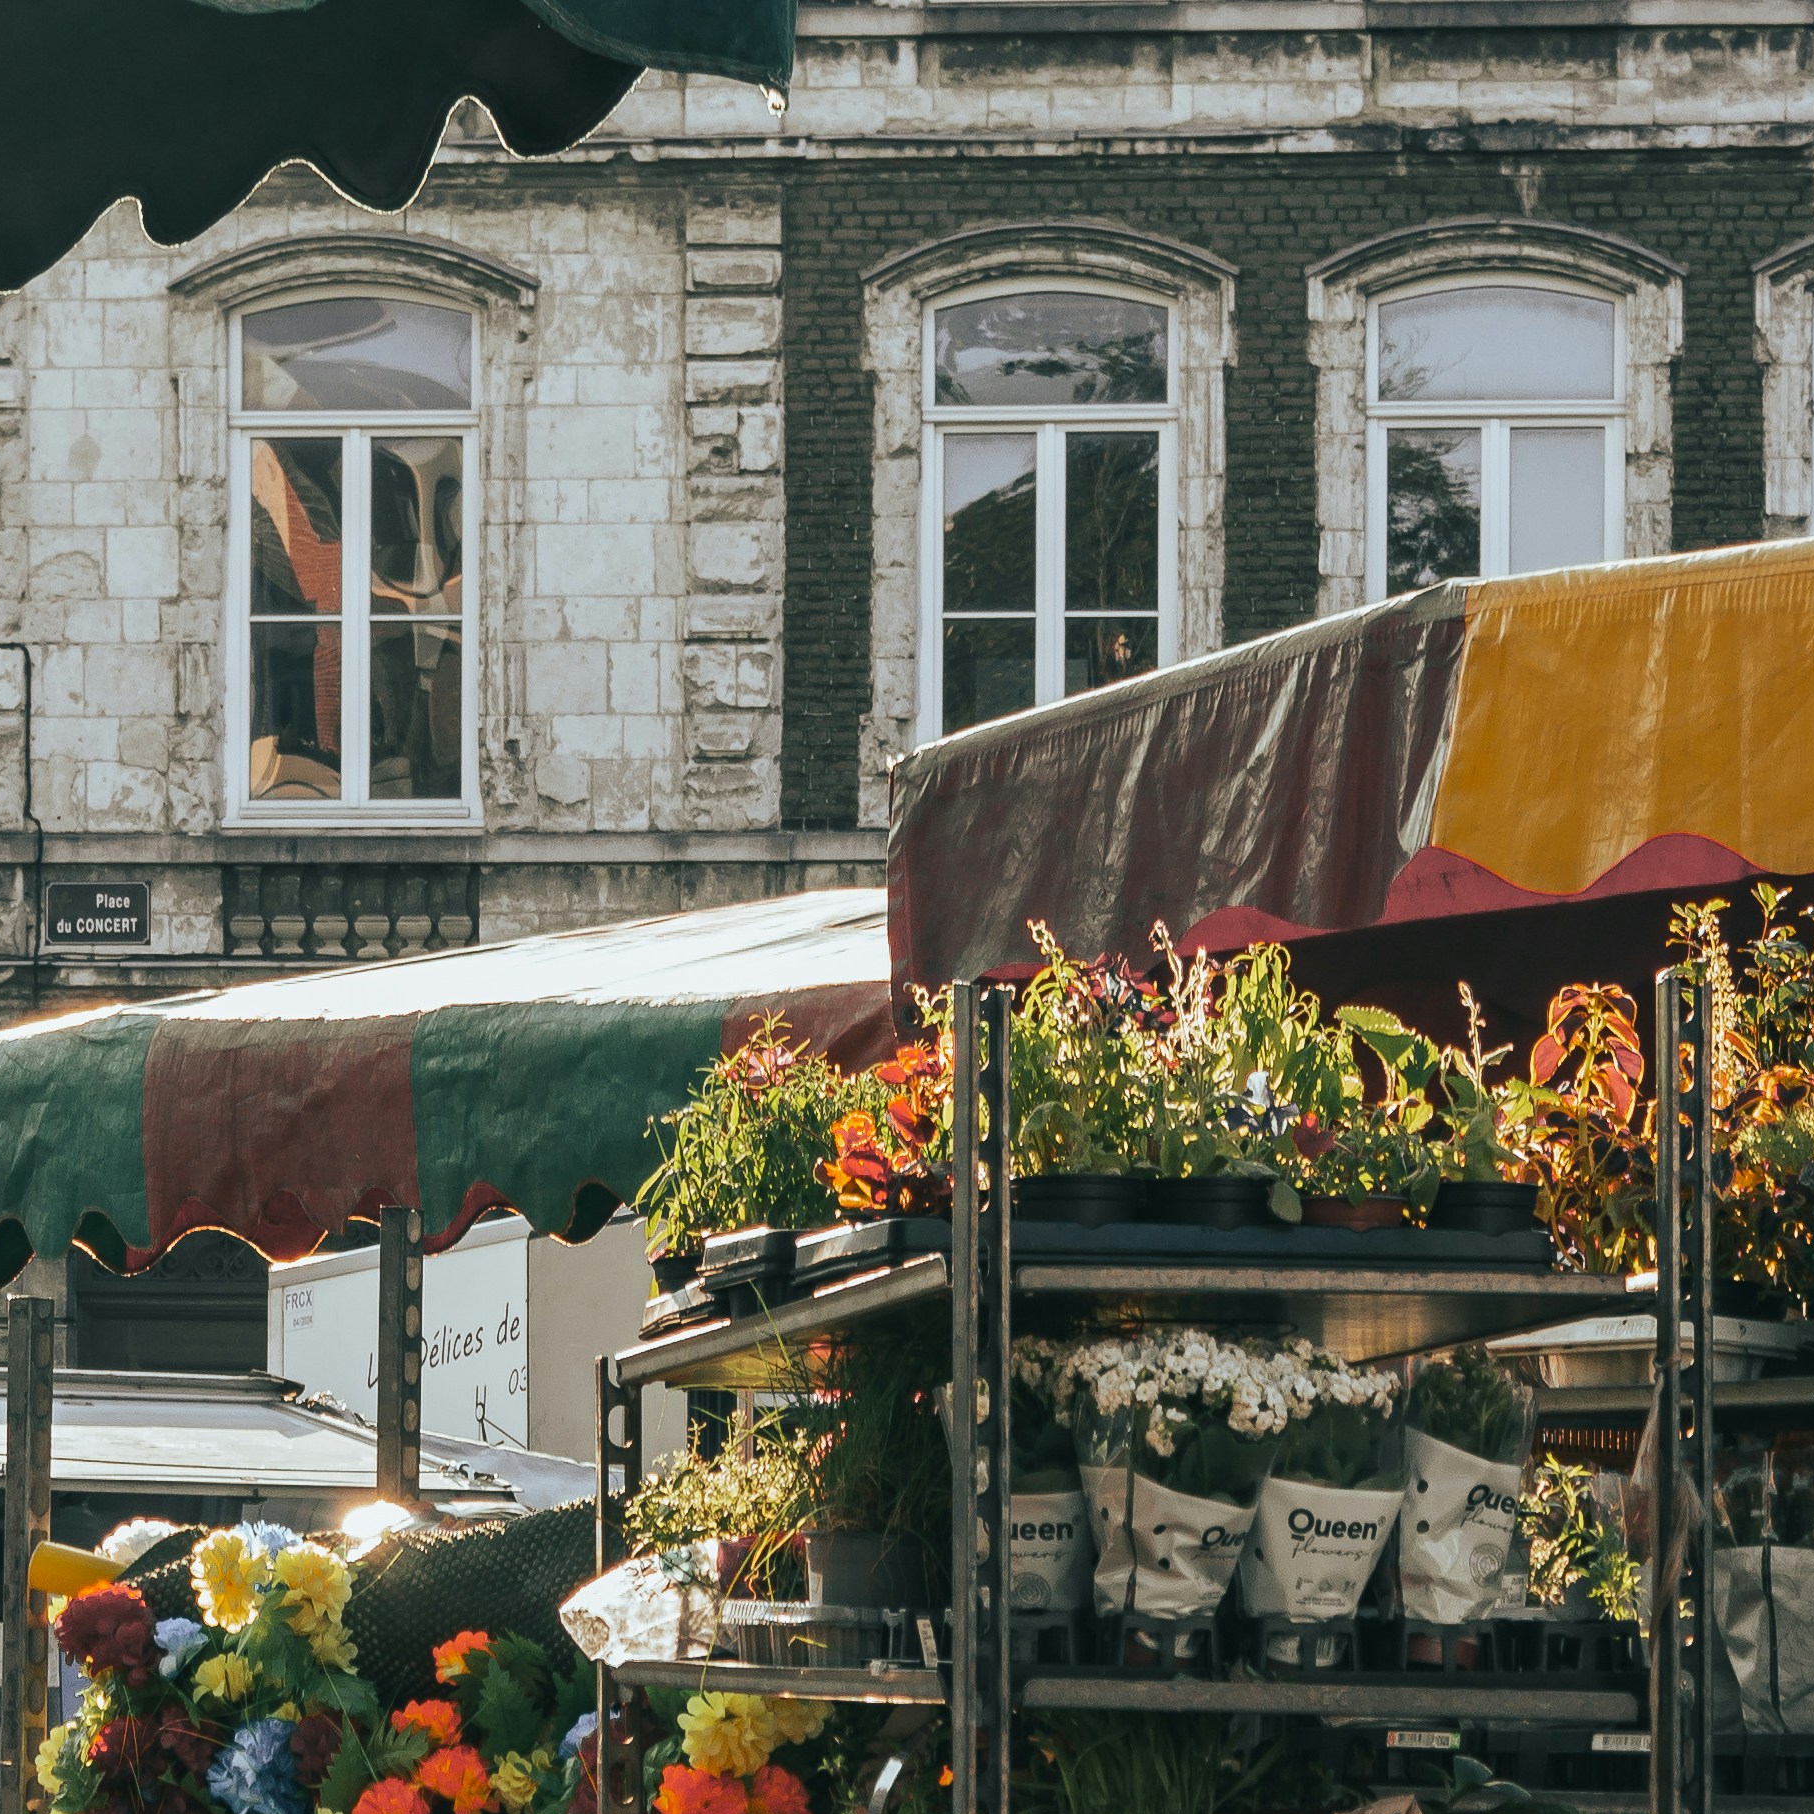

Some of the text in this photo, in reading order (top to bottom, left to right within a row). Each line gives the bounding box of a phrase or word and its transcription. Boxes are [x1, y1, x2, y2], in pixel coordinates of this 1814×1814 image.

[96, 893, 131, 909] Place
[56, 917, 138, 934] du CONCERT
[285, 1289, 313, 1311] FRCX
[496, 1302, 521, 1346] de
[1465, 1484, 1517, 1514] Que
[1011, 1521, 1073, 1542] ueen
[1288, 1508, 1379, 1542] Queen
